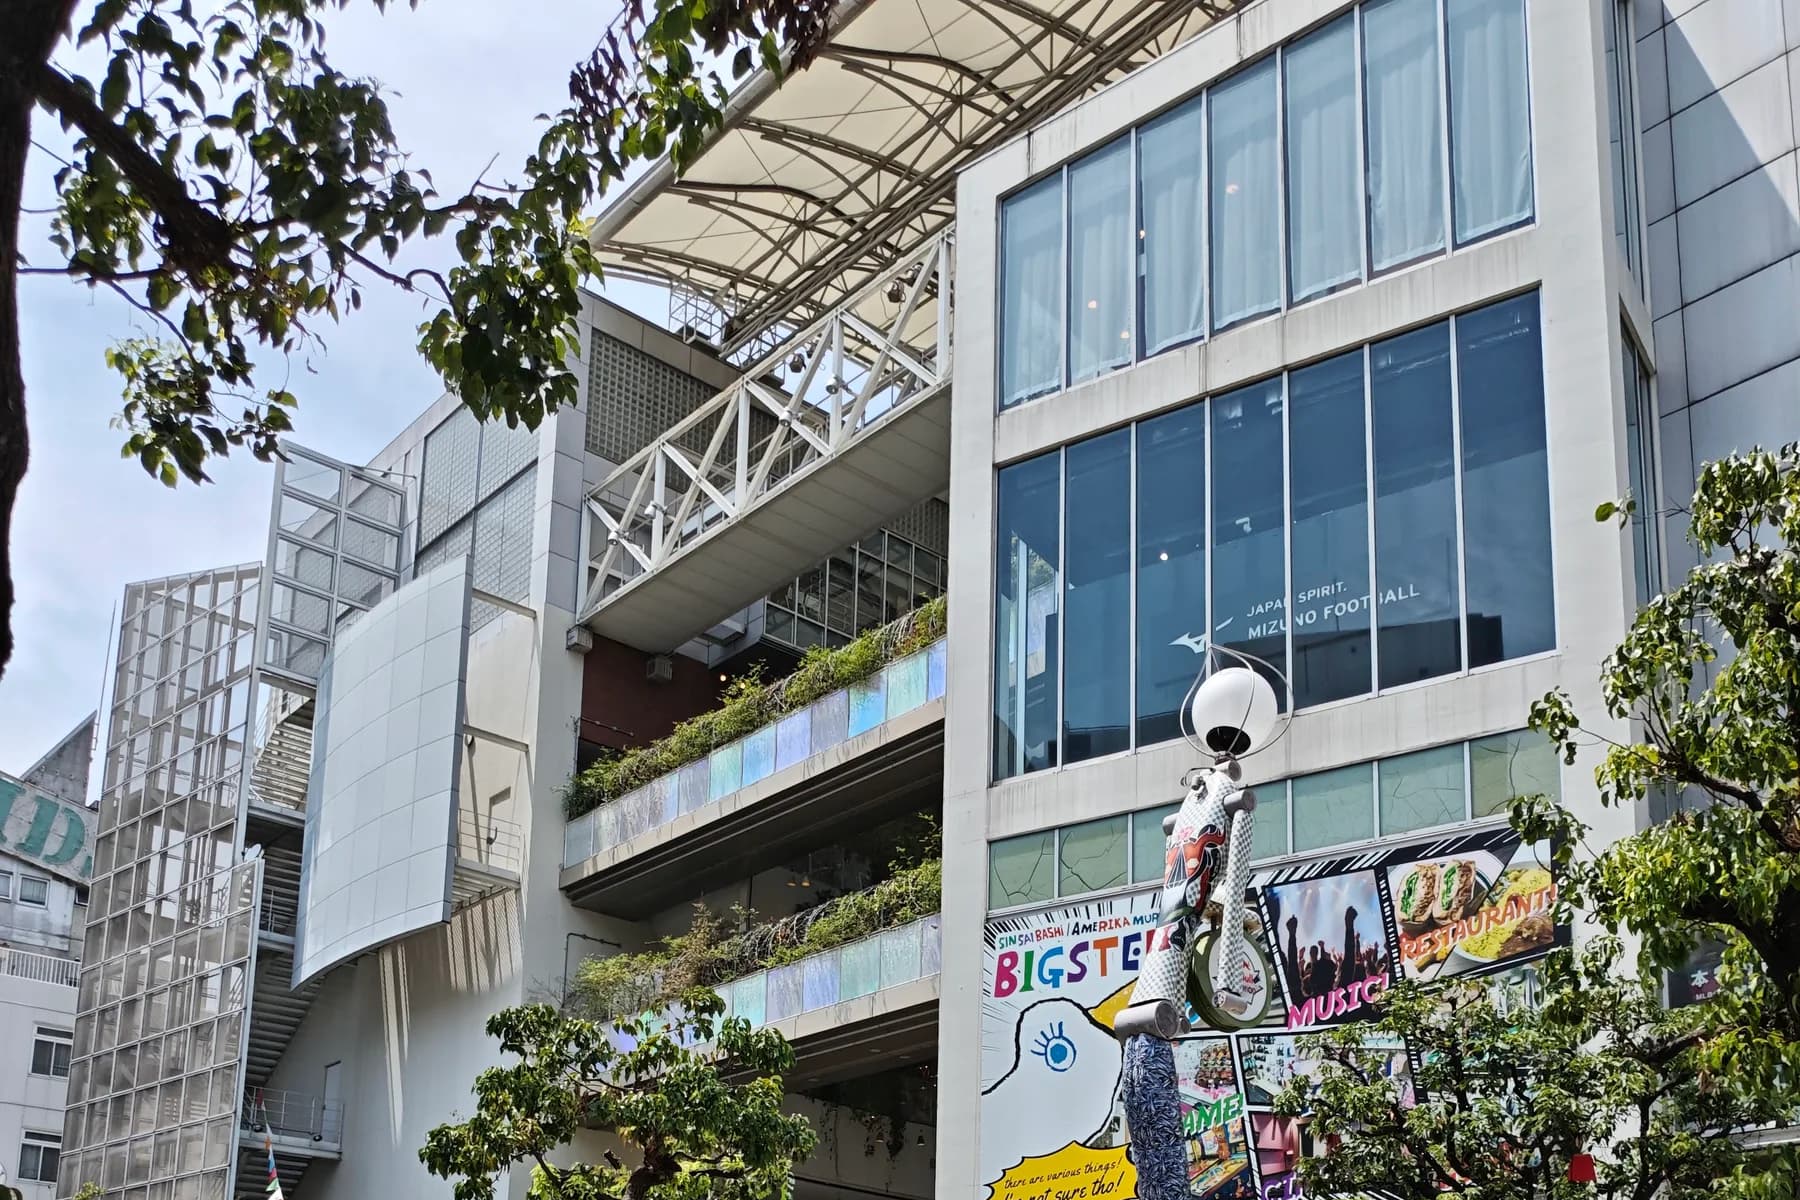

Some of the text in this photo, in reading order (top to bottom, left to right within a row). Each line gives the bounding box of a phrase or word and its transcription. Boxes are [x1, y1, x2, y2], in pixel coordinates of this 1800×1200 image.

[1298, 581, 1347, 603] SPIRIT.
[1133, 912, 1160, 925] MUR
[1399, 882, 1558, 966] RESTAURANT!
[1182, 1093, 1243, 1138] AME!
[1004, 1156, 1123, 1189] there are various things!
[1091, 1171, 1125, 1197] tho!
